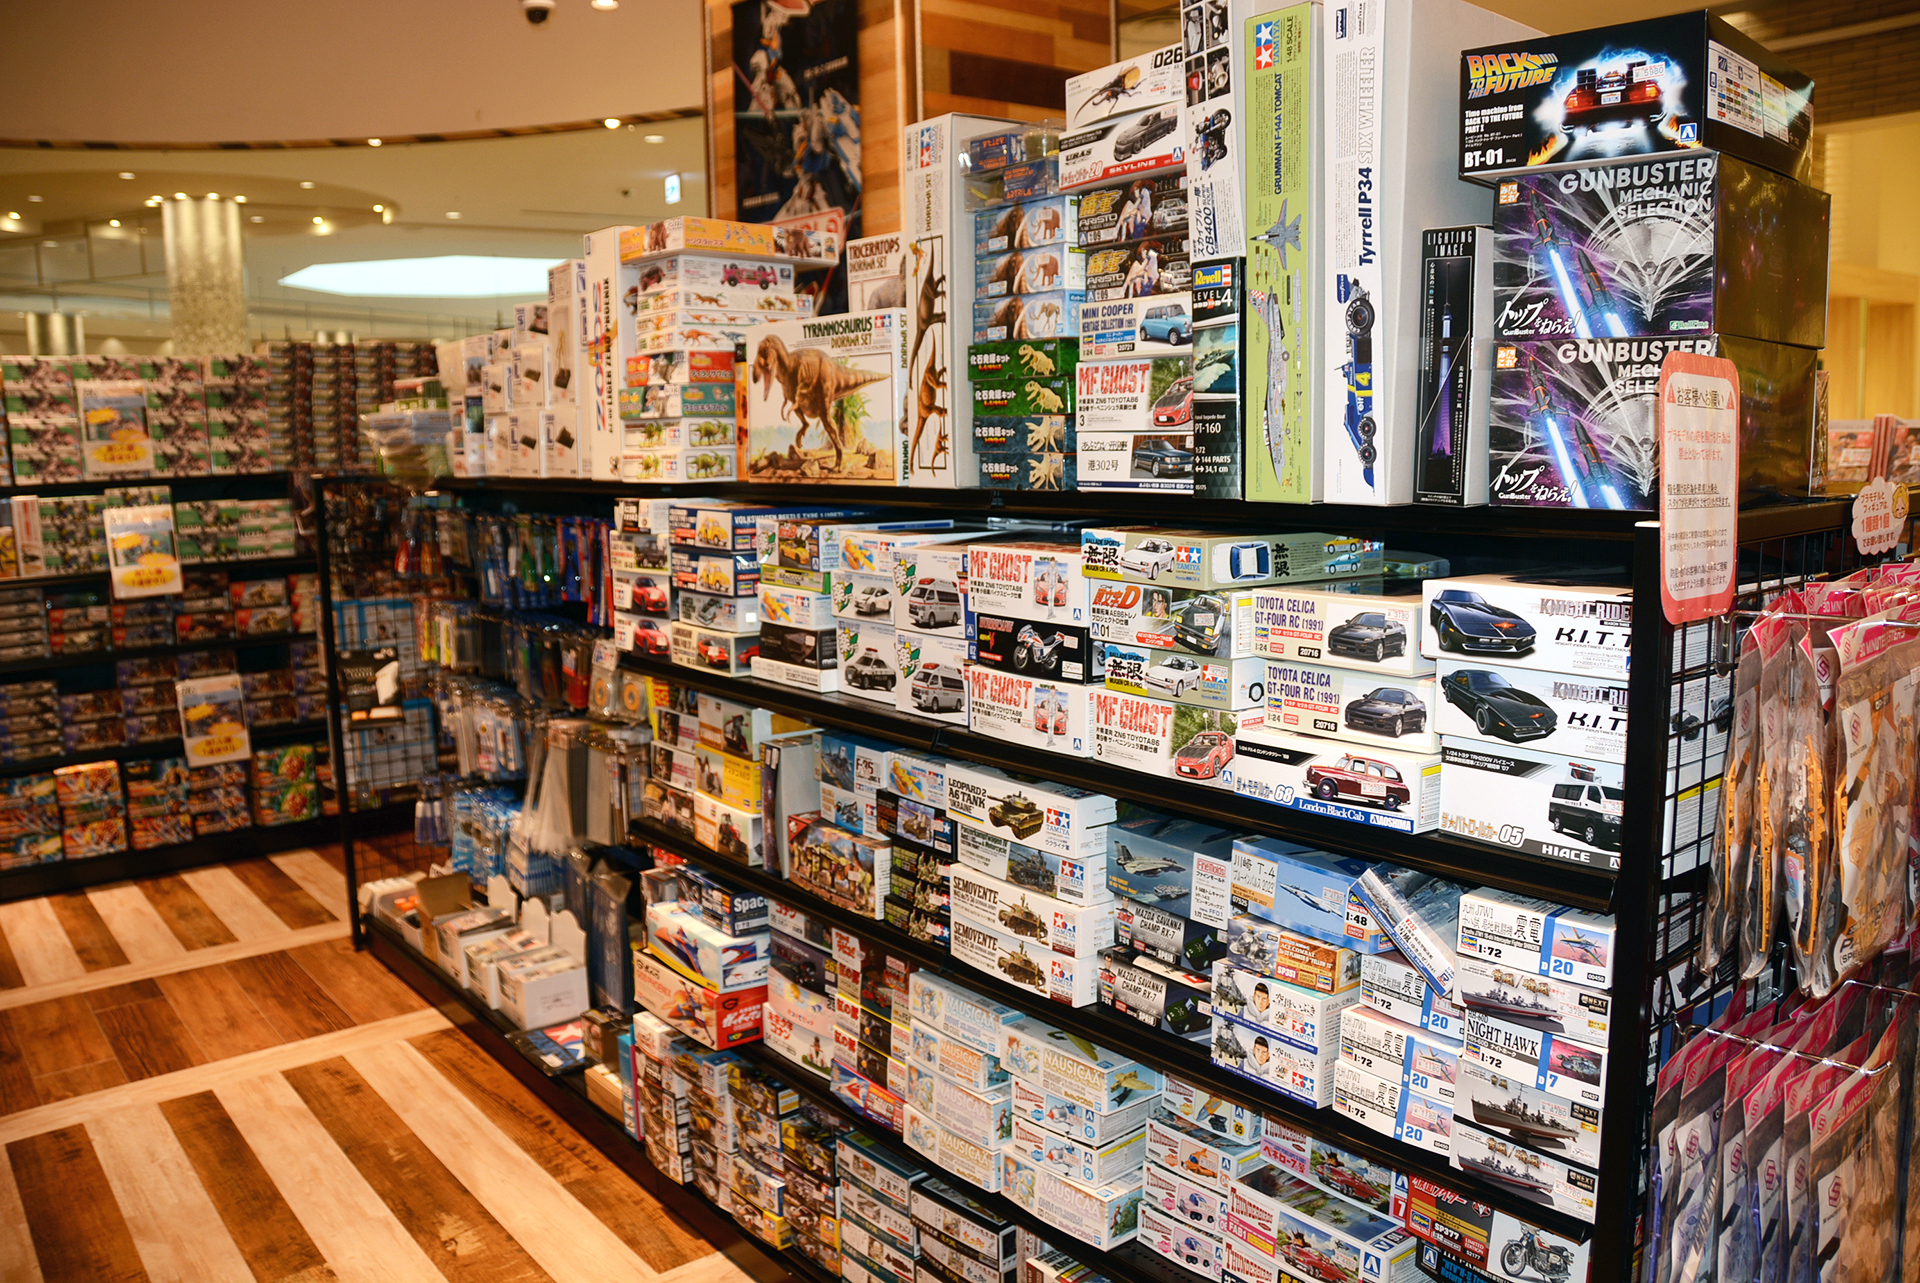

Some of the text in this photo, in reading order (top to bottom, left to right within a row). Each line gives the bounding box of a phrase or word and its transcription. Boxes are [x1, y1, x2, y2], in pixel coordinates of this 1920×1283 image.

[1273, 19, 1281, 67] TAMIYA
[1466, 53, 1536, 80] BACK
[1485, 65, 1557, 97] FUTURE
[1358, 46, 1376, 266] Tyrrell P34 SIX WHEELER
[1465, 147, 1504, 168] BT-01
[1274, 142, 1282, 195] GRUMMAN
[1559, 159, 1713, 194] GUNBUSTER
[1620, 180, 1712, 203] MECHANIC
[1617, 197, 1711, 219] SELECTION
[1203, 206, 1215, 256] CB400
[1195, 268, 1221, 285] Revell
[1082, 303, 1133, 320] MINI COOPER
[802, 317, 872, 339] TYRANNOSAURUS
[861, 333, 873, 346] SET
[1101, 363, 1150, 394] GHOST
[1084, 545, 1119, 566] 無限
[988, 554, 1033, 583] GHOST
[1176, 563, 1201, 572] TAMIYA
[1255, 596, 1315, 615] TOYOTA CELICA
[1540, 598, 1594, 618] KNIGHT
[1254, 611, 1324, 632] GT-FOUR RC (1991)
[1300, 647, 1319, 658] 20716
[1108, 659, 1144, 681] 無限
[1267, 666, 1331, 687] TOYOTA CELICA
[990, 675, 1032, 709] GHOST
[1202, 682, 1227, 691] TAMIYA
[1267, 681, 1340, 704] GT-FOUR RC (1991)
[1552, 681, 1606, 704] KNIGHT
[1120, 699, 1172, 738] GHOST
[1268, 713, 1281, 722] 1:24
[1315, 720, 1335, 732] 20716
[948, 777, 981, 796] LEOPARD
[1274, 784, 1295, 806] 68
[948, 788, 986, 809] A6 TANK
[1327, 804, 1347, 818] Black
[1347, 807, 1365, 822] Cab
[1046, 823, 1070, 837] TAMIYA
[1498, 824, 1524, 846] 05
[1542, 844, 1591, 862] HIACE
[1257, 862, 1276, 879] T-4
[952, 876, 998, 904] SEMOVENTE
[1345, 911, 1368, 927] 1:48
[952, 921, 998, 951] SEMOVENTE
[1478, 944, 1502, 959] 1:72
[1553, 959, 1574, 976] 20
[1373, 996, 1392, 1011] 1:72
[1432, 1014, 1449, 1030] 20
[1292, 1032, 1315, 1043] TAMIYA
[1467, 1018, 1540, 1057] NIGHT HAWK
[1354, 1053, 1373, 1069] 1:72
[1480, 1052, 1502, 1068] 1:72
[1412, 1074, 1429, 1090] 20
[1549, 1073, 1558, 1088] 7
[1292, 1085, 1315, 1097] TAMIYA
[1347, 1105, 1366, 1119] 1:72
[1405, 1126, 1423, 1142] 20
